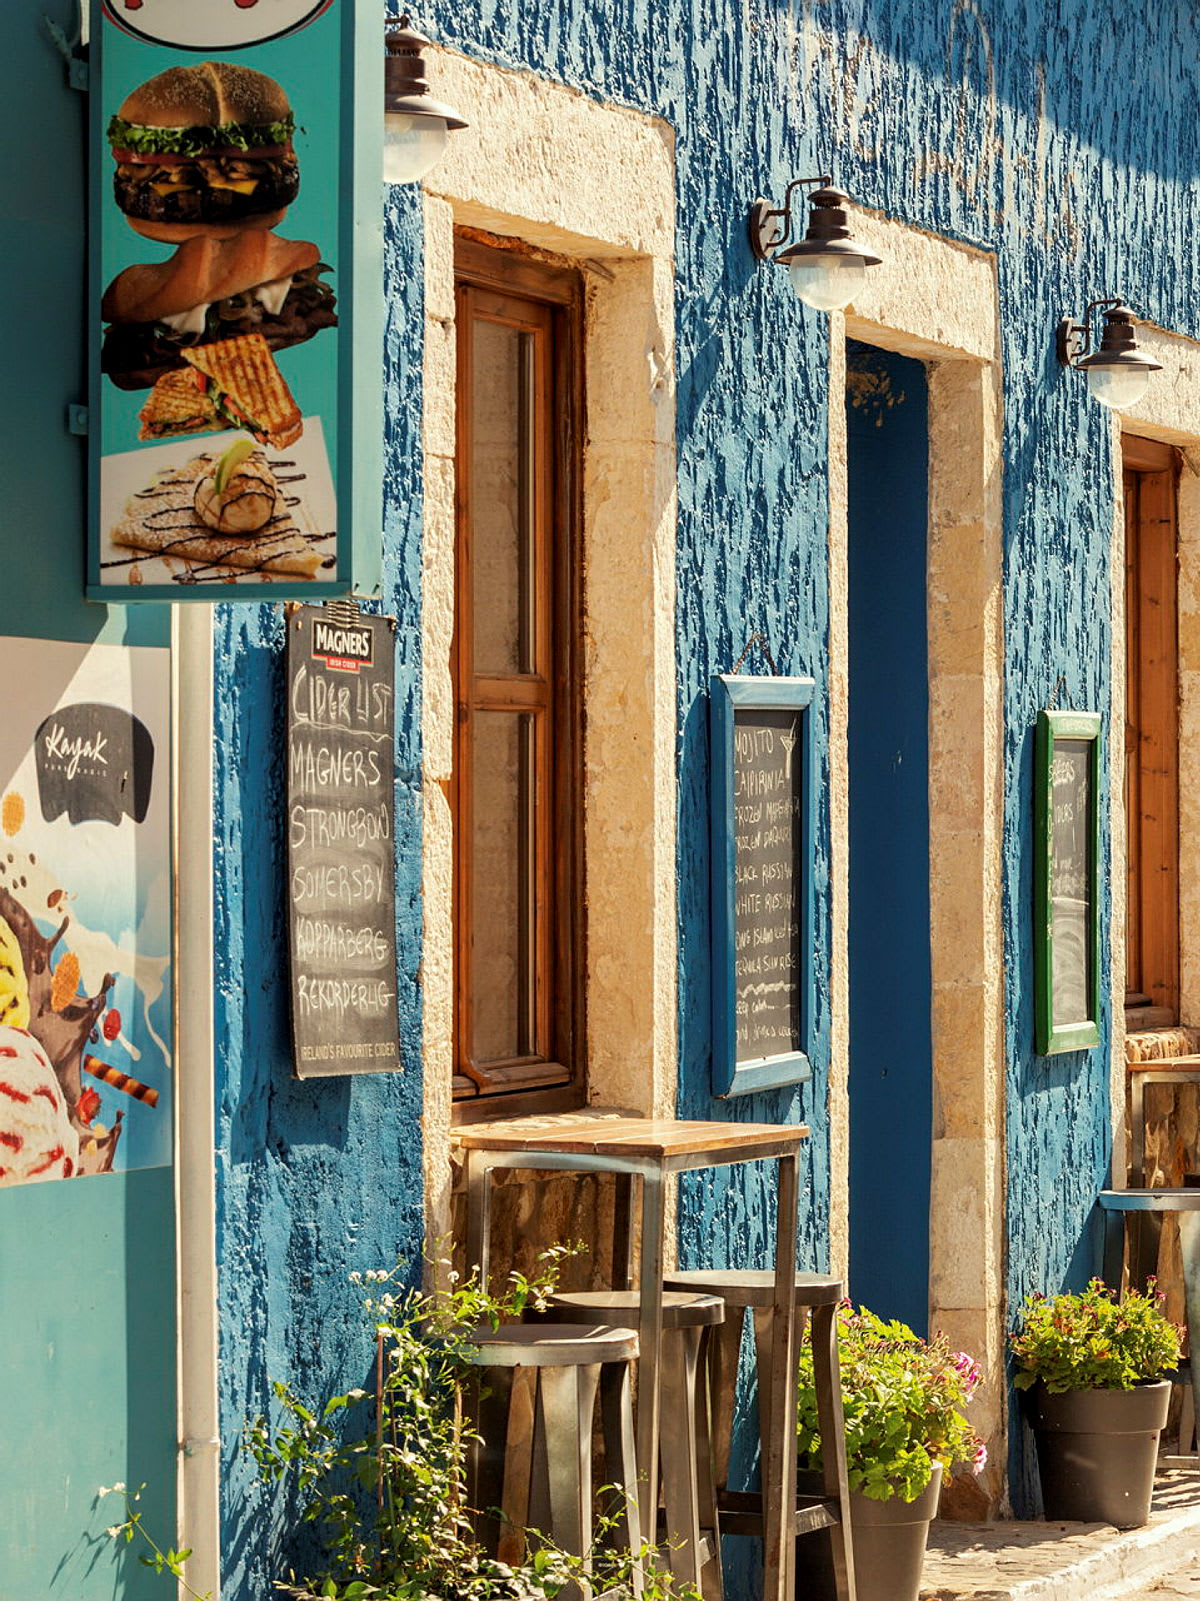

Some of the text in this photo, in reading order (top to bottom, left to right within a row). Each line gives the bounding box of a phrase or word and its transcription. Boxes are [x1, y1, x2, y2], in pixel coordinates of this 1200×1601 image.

[316, 623, 370, 657] MAGNERS
[292, 663, 392, 725] CIDER LIST
[45, 723, 109, 780] Kayak
[290, 741, 381, 794] MAGNERS
[291, 802, 389, 848] STRONGBOW
[292, 863, 384, 904] SOMERSBY
[296, 916, 388, 962] KOPPARBERG
[297, 975, 395, 1016] REKORDERLIG
